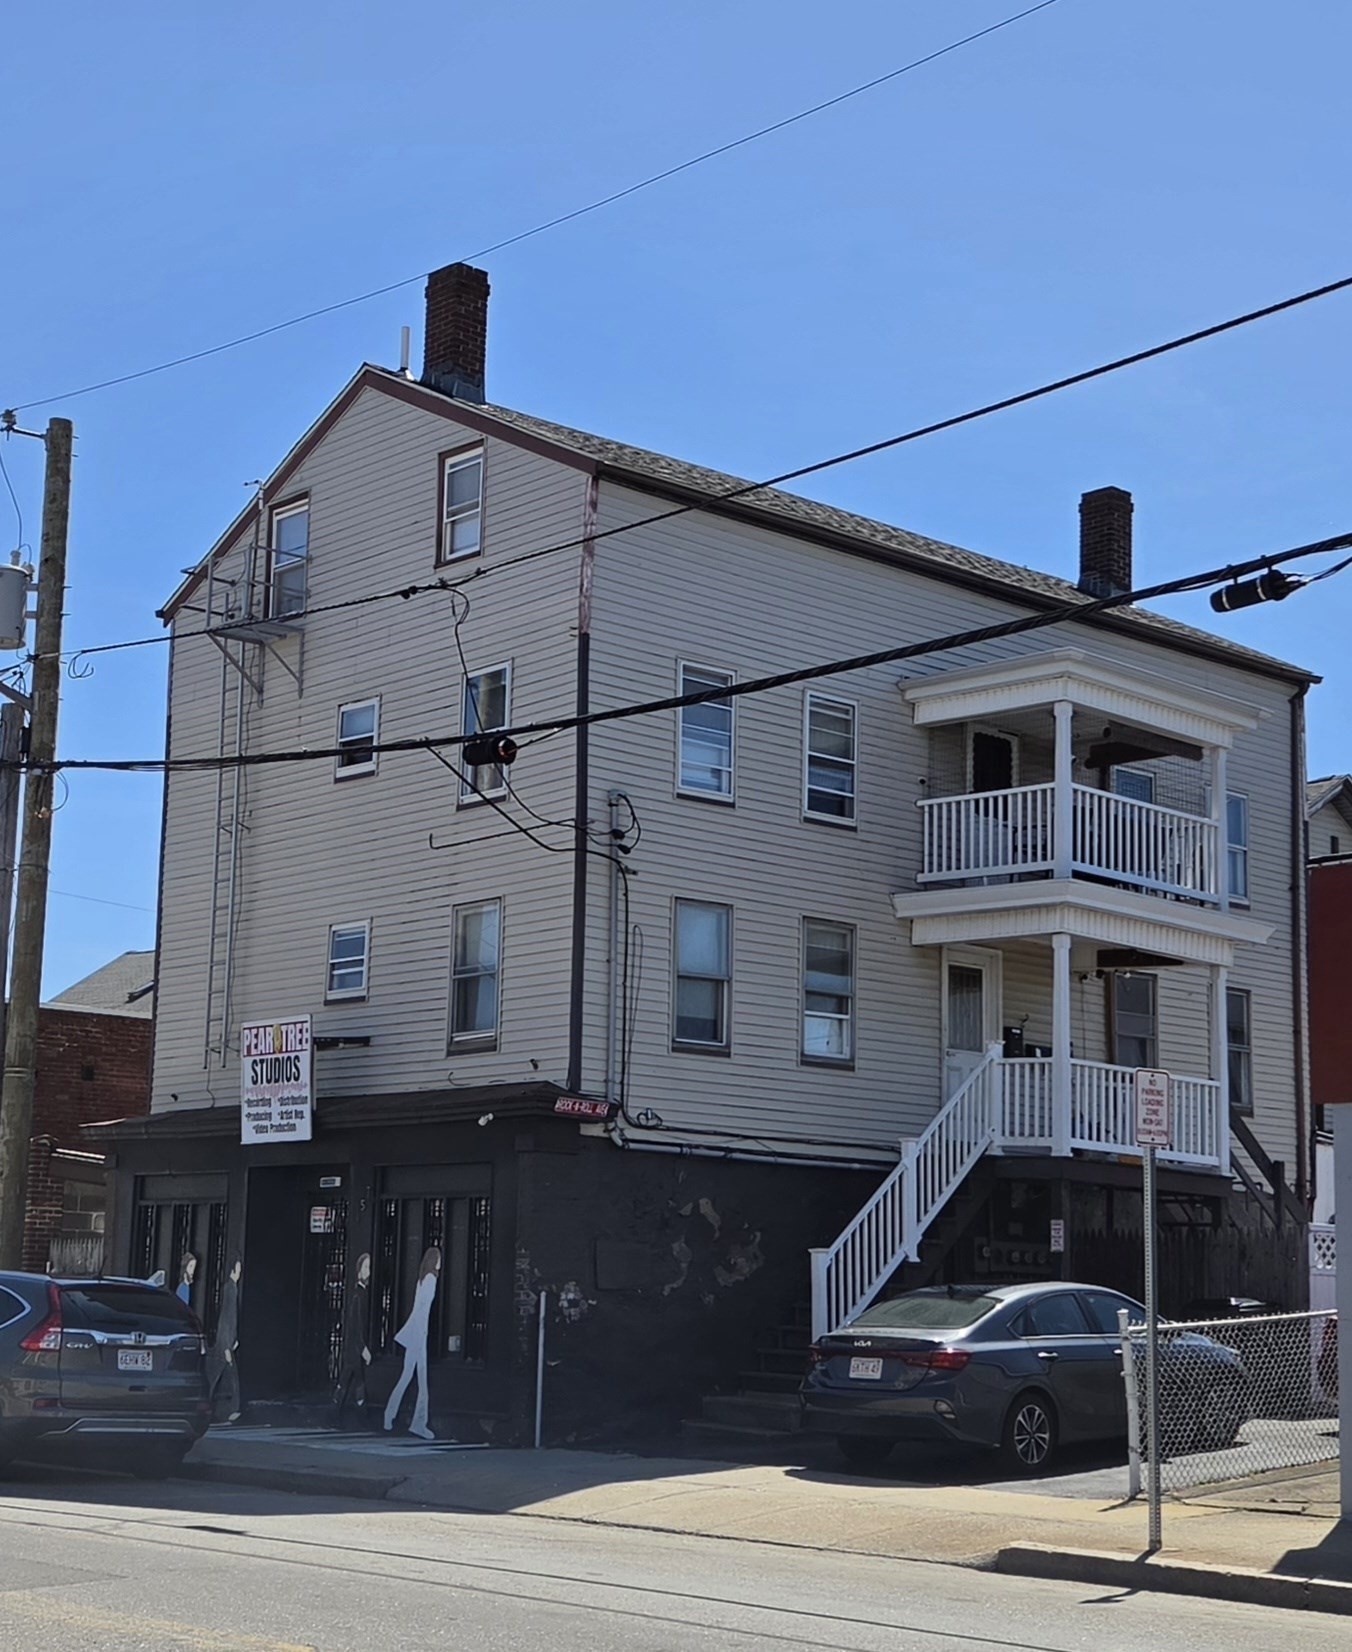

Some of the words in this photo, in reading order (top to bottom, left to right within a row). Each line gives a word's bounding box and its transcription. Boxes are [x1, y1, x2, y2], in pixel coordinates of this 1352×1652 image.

[244, 1028, 273, 1056] PEAR
[281, 1023, 308, 1052] TREE
[251, 1055, 300, 1085] STUDIOS
[1149, 1079, 1157, 1087] NO
[1141, 1087, 1164, 1097] PARKING
[1141, 1098, 1164, 1107] LOADING
[1145, 1108, 1160, 1117] ZONE
[269, 1121, 297, 1133] Production
